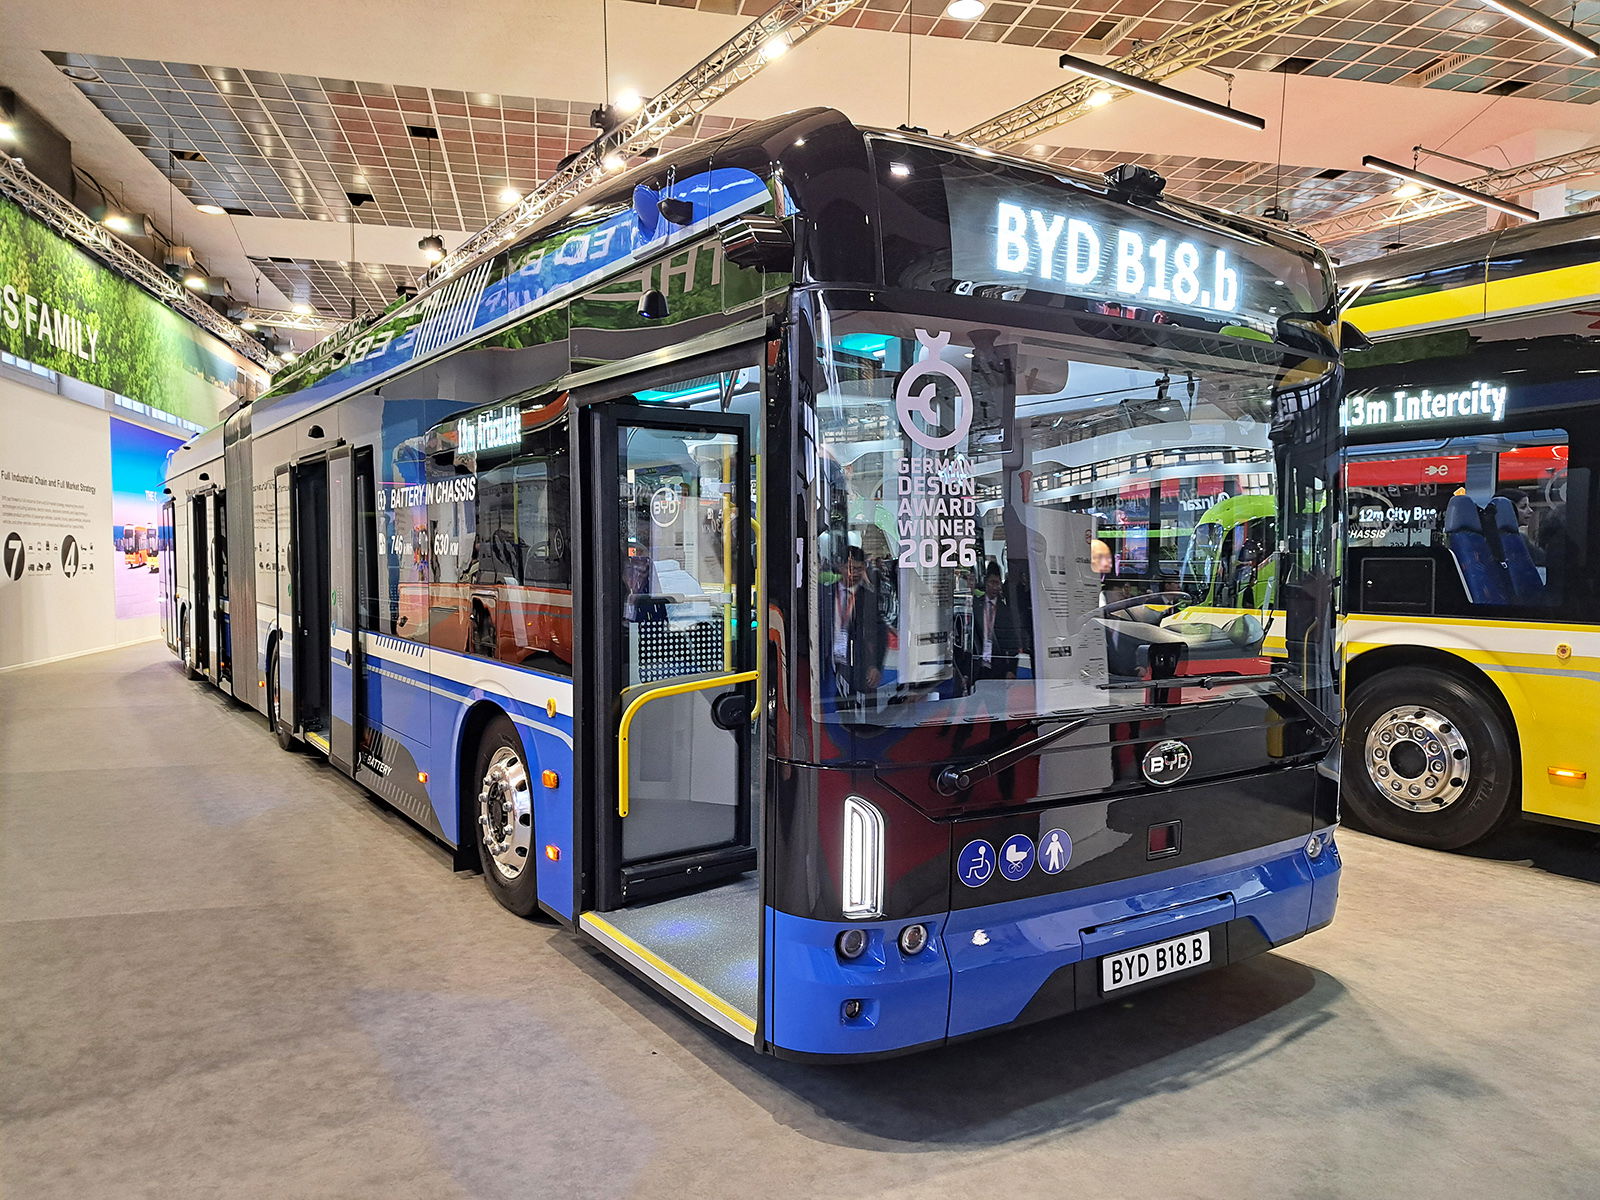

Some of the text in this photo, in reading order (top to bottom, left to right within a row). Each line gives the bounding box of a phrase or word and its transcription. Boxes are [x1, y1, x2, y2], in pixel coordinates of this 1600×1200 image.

[995, 201, 1238, 312] BYD B18.b
[0, 284, 99, 363] S FAMILY
[1393, 381, 1506, 421] Intercity
[898, 458, 975, 474] GERMAN
[1, 470, 96, 496] Full Industrial Chain and Full Market Strategy
[390, 476, 476, 509] BATTERY IN CHASSIS
[898, 475, 975, 496] DESIGN
[653, 501, 676, 515] BYD
[898, 498, 976, 517] AWARD
[1358, 508, 1384, 523] 12m
[1386, 506, 1412, 524] City
[898, 519, 976, 537] WINNER
[390, 534, 404, 555] 746
[433, 533, 450, 556] 630
[898, 538, 977, 568] 2026
[8, 540, 22, 580] 7
[63, 541, 77, 579] 4
[366, 755, 393, 777] BATTERY
[1150, 753, 1188, 773] BYD
[1111, 938, 1203, 985] BYD B18.B
